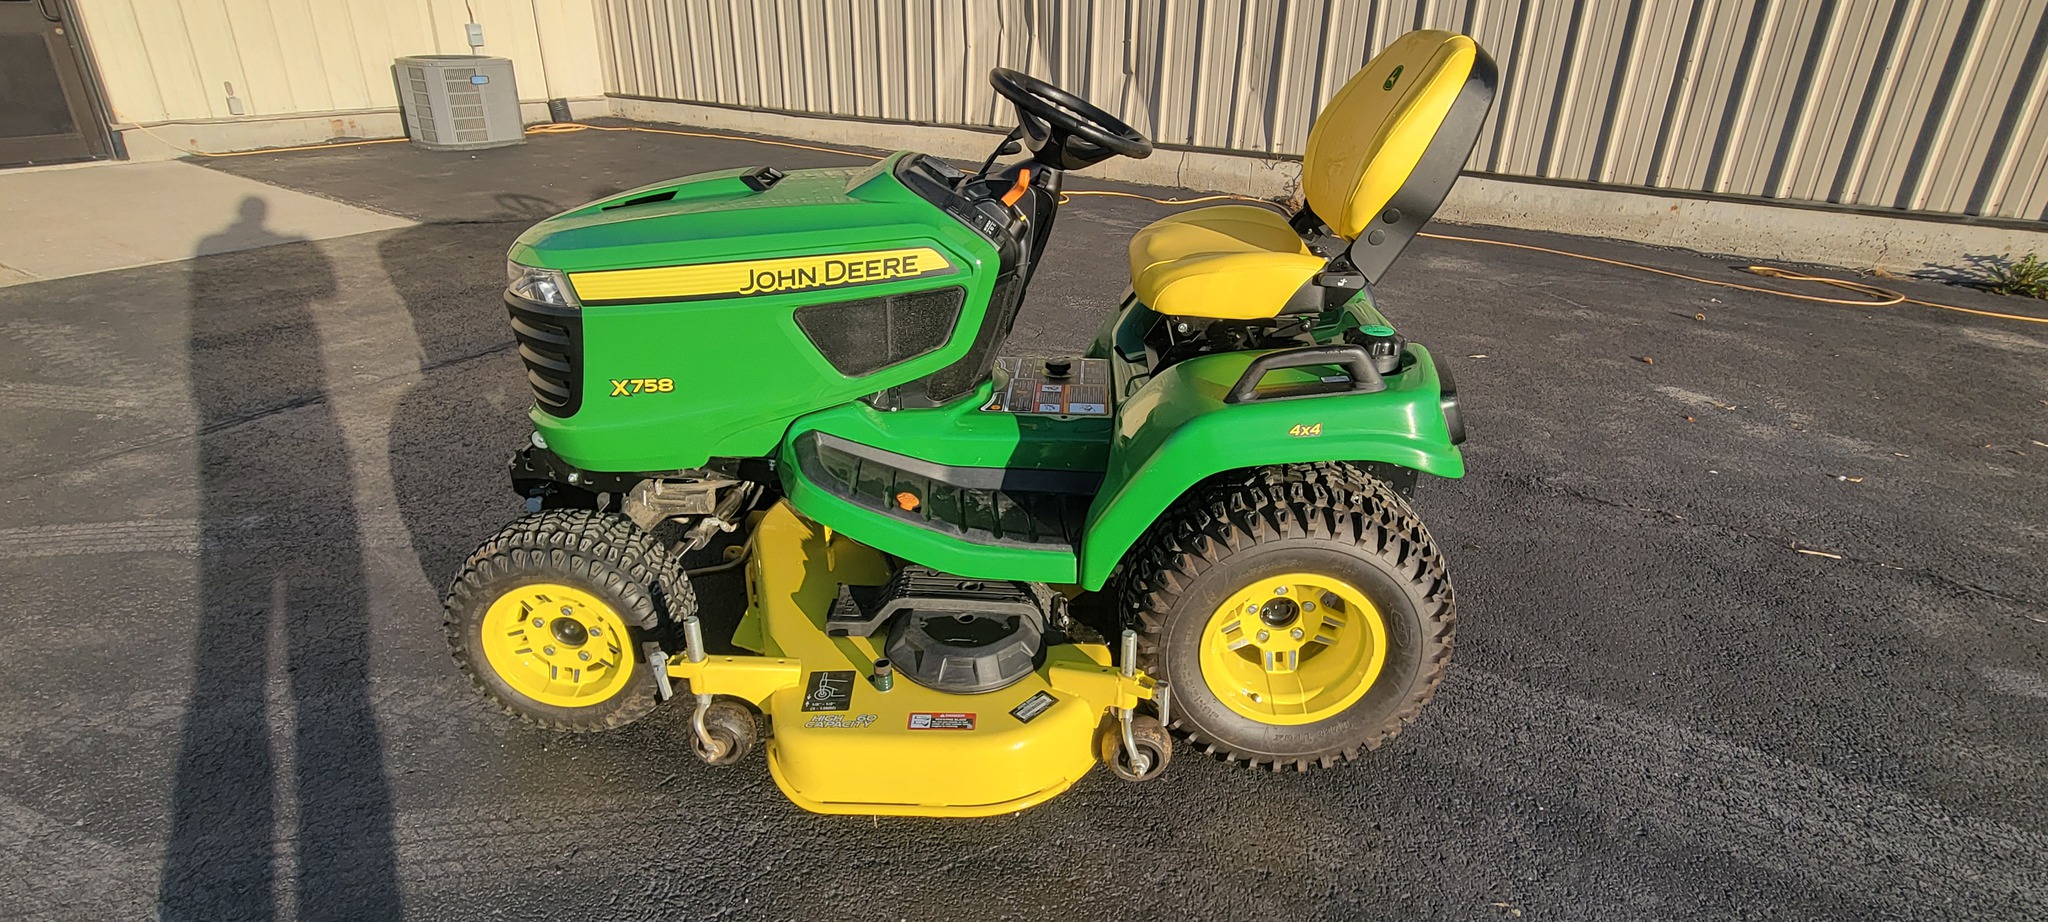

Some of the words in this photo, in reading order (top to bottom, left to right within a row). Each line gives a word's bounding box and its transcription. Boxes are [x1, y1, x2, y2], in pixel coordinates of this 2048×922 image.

[739, 267, 816, 291] JOHN
[825, 255, 918, 282] DEERE
[609, 377, 674, 397] X758
[1288, 422, 1321, 436] 4x4
[811, 714, 845, 722] HIGH
